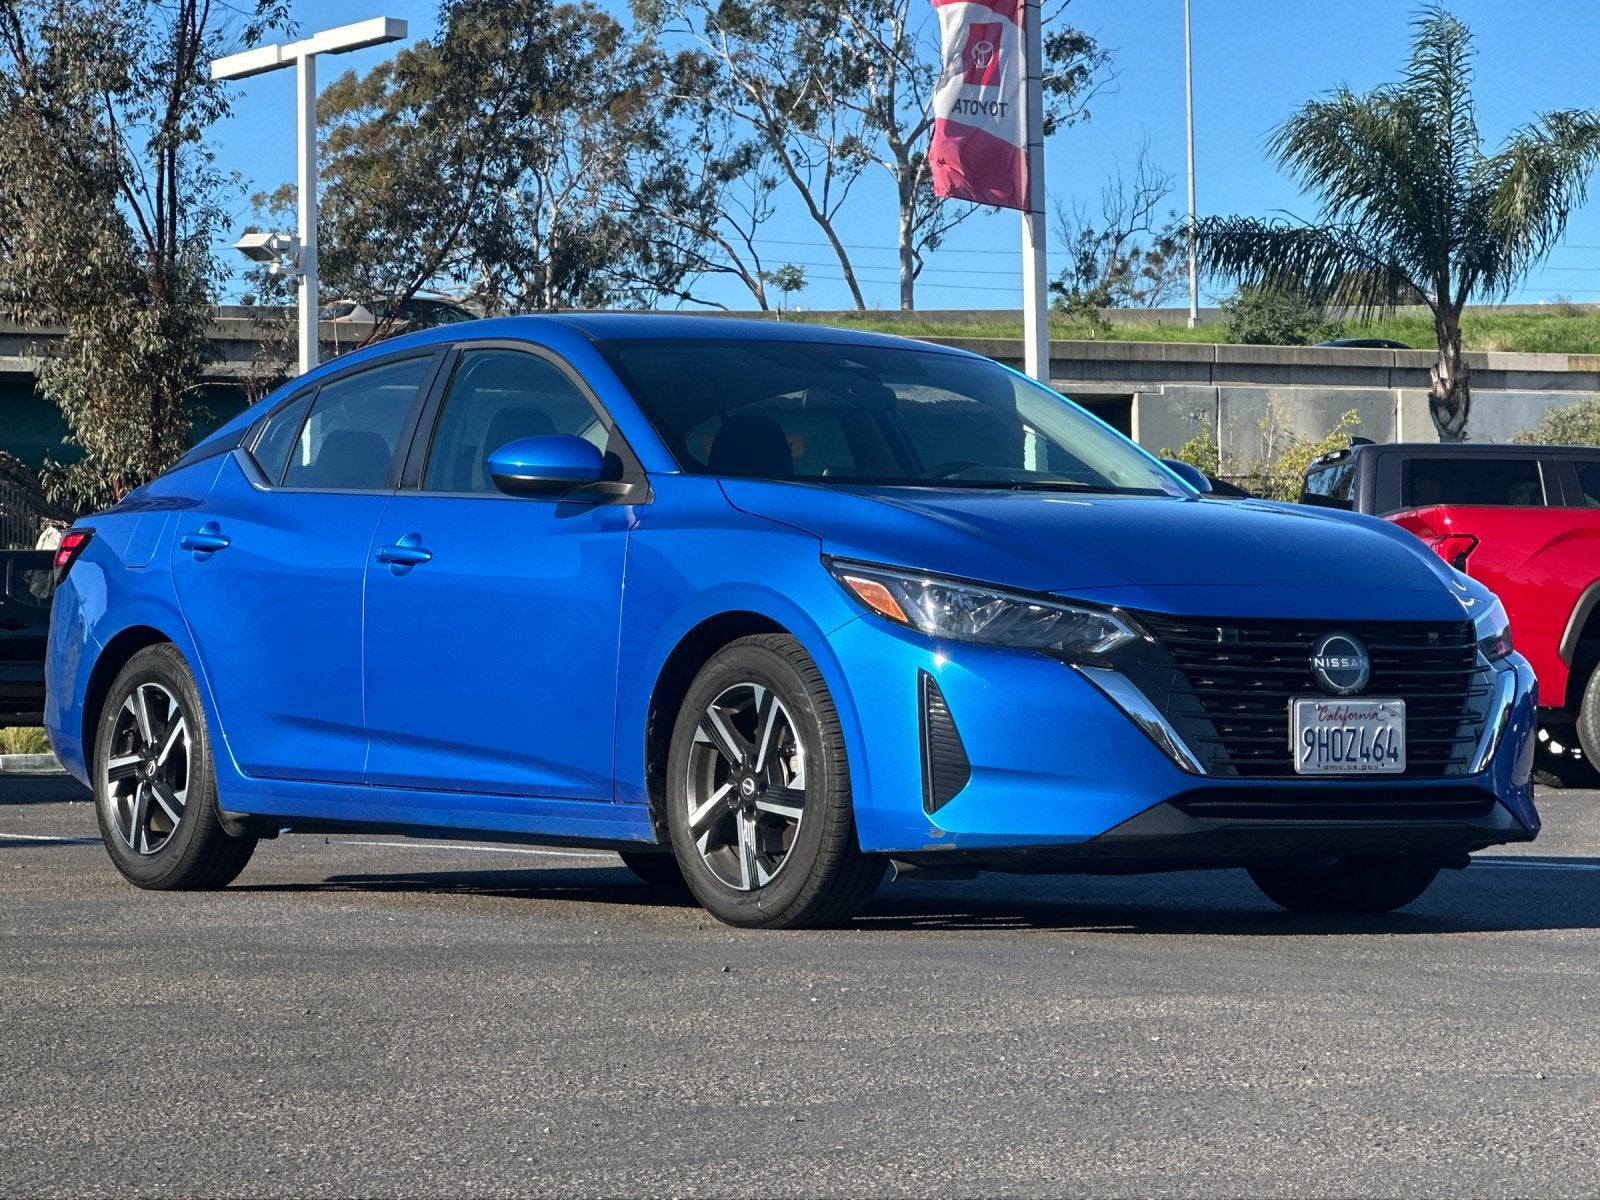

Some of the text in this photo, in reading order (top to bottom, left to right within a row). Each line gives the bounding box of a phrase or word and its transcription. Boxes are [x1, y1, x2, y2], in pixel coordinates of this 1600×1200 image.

[1314, 657, 1367, 668] NISSAN
[1317, 705, 1385, 727] California
[1323, 763, 1379, 771] dmv.ca.gov
